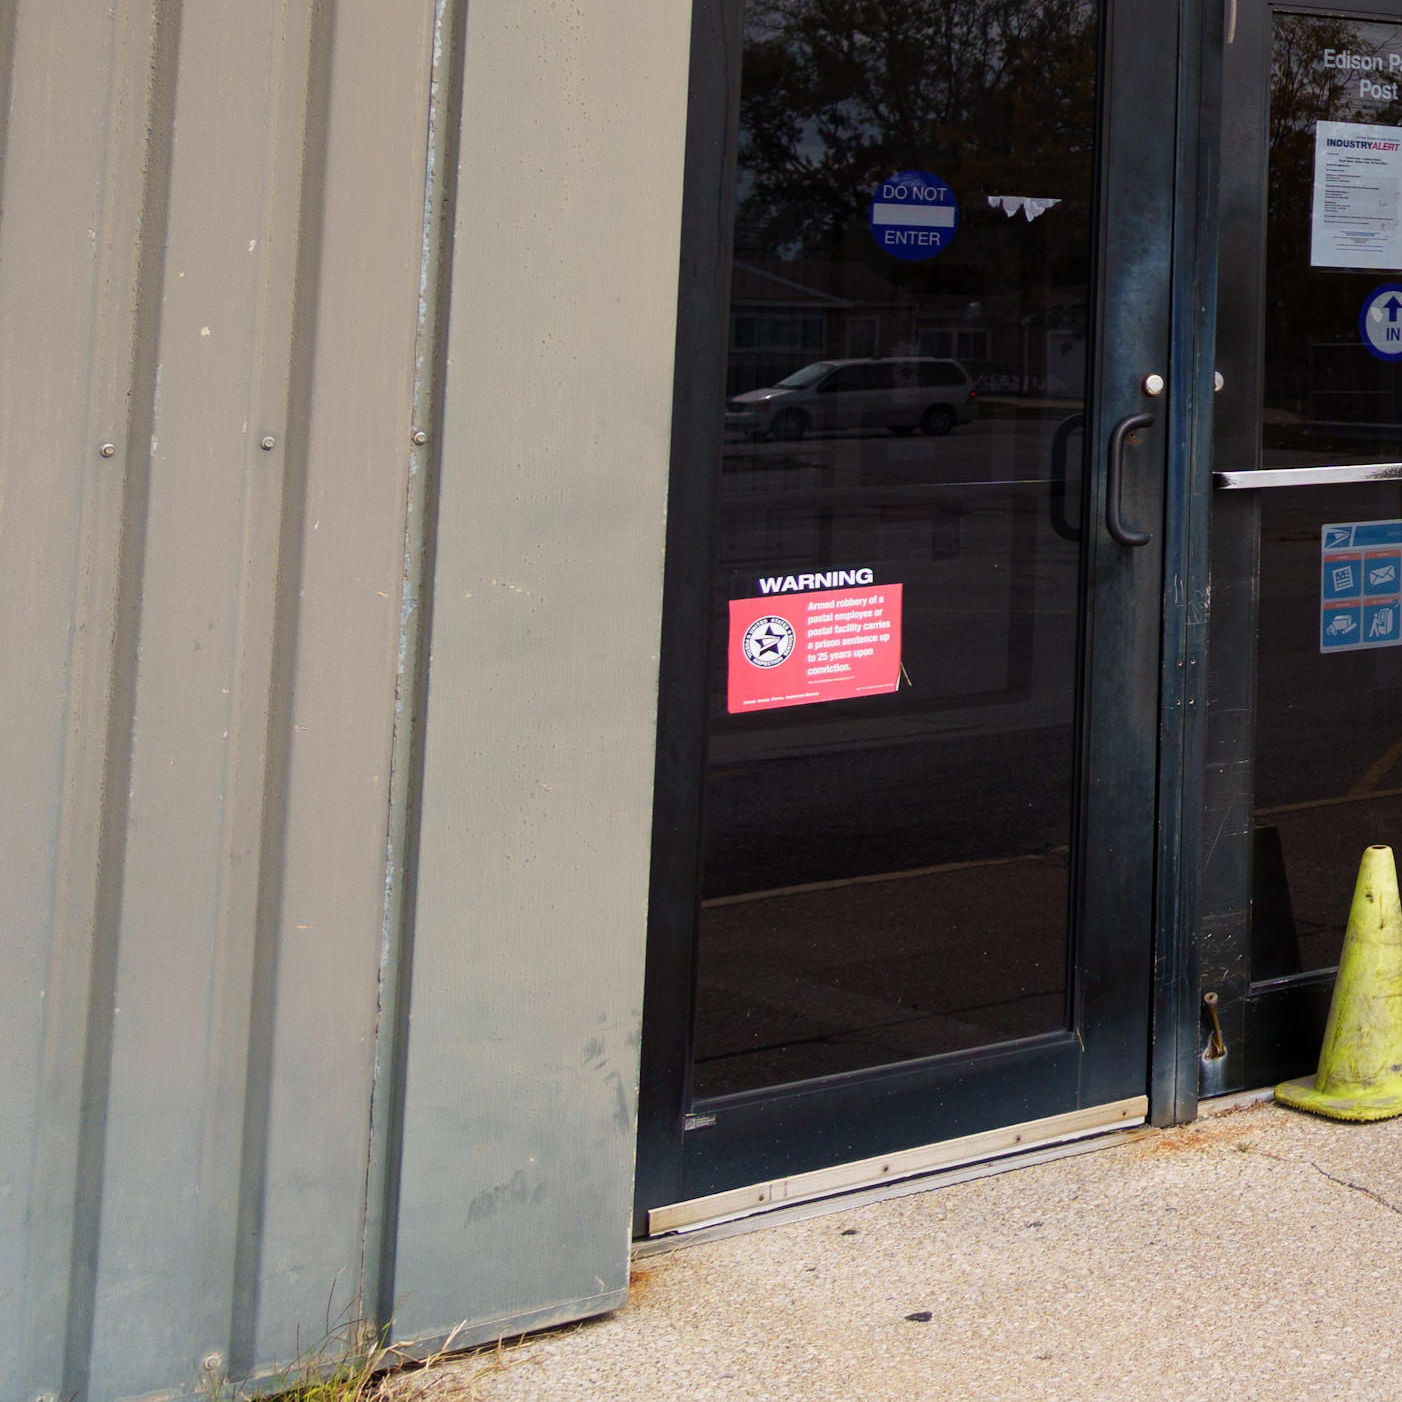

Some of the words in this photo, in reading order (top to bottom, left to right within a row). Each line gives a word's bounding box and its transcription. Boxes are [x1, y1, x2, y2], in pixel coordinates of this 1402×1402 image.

[1323, 48, 1383, 71] Edison
[1359, 79, 1398, 100] Post
[1326, 138, 1400, 152] INDUSTRYALERT
[882, 185, 908, 200] DO
[912, 186, 948, 202] NOT
[884, 230, 941, 246] ENTER
[1385, 327, 1401, 341] IN
[759, 568, 874, 594] WARNING
[808, 599, 835, 611] Armed
[836, 597, 867, 608] robbery
[869, 595, 878, 604] of
[808, 613, 833, 625] postal
[834, 610, 872, 621] employee
[874, 609, 883, 617] or
[808, 625, 833, 638] postal
[834, 622, 862, 634] facility
[863, 620, 891, 630] carries
[815, 639, 841, 650] prison
[842, 634, 878, 646] sentence
[879, 634, 890, 643] up
[807, 654, 816, 662] to
[817, 652, 828, 661] 25
[829, 650, 852, 662] years
[853, 648, 874, 659] upon
[807, 663, 852, 675] conviction.
